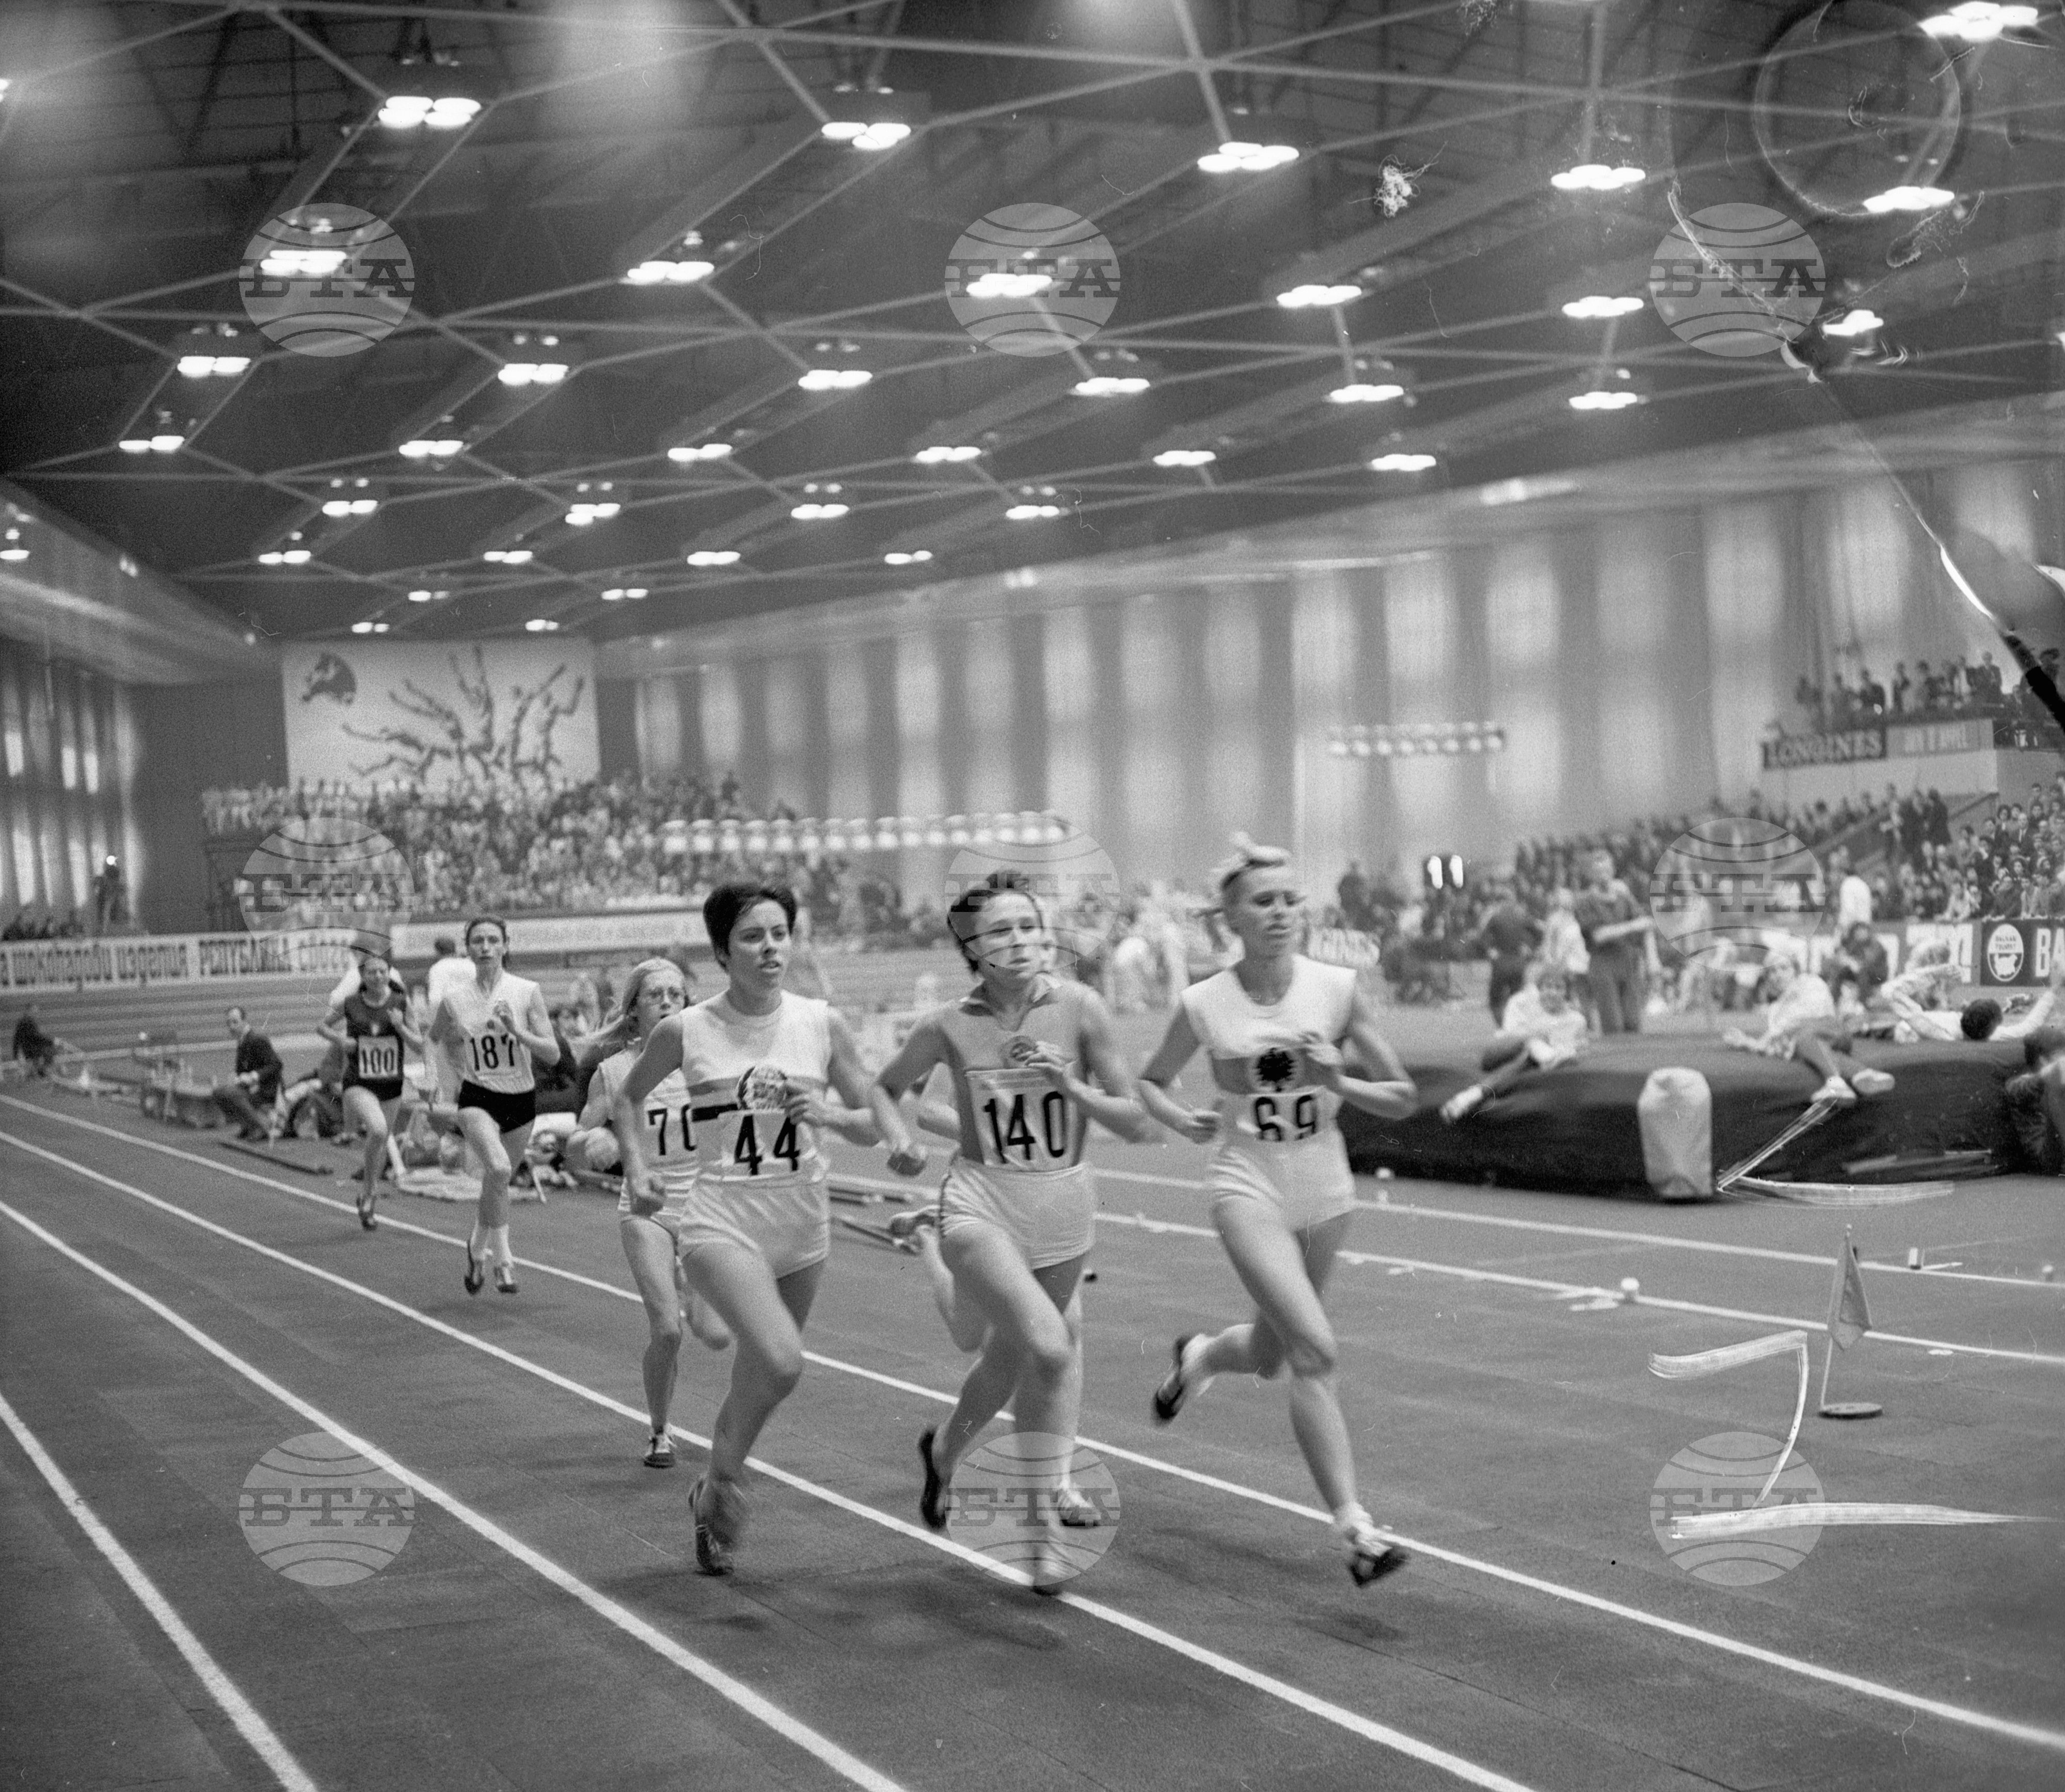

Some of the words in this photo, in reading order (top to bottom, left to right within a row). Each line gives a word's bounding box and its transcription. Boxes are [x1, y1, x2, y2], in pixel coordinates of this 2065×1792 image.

[362, 1048, 394, 1074] 100
[470, 1034, 514, 1071] 187
[984, 1091, 1065, 1164] 140
[1254, 1095, 1316, 1142] 69
[735, 1113, 800, 1175] 44
